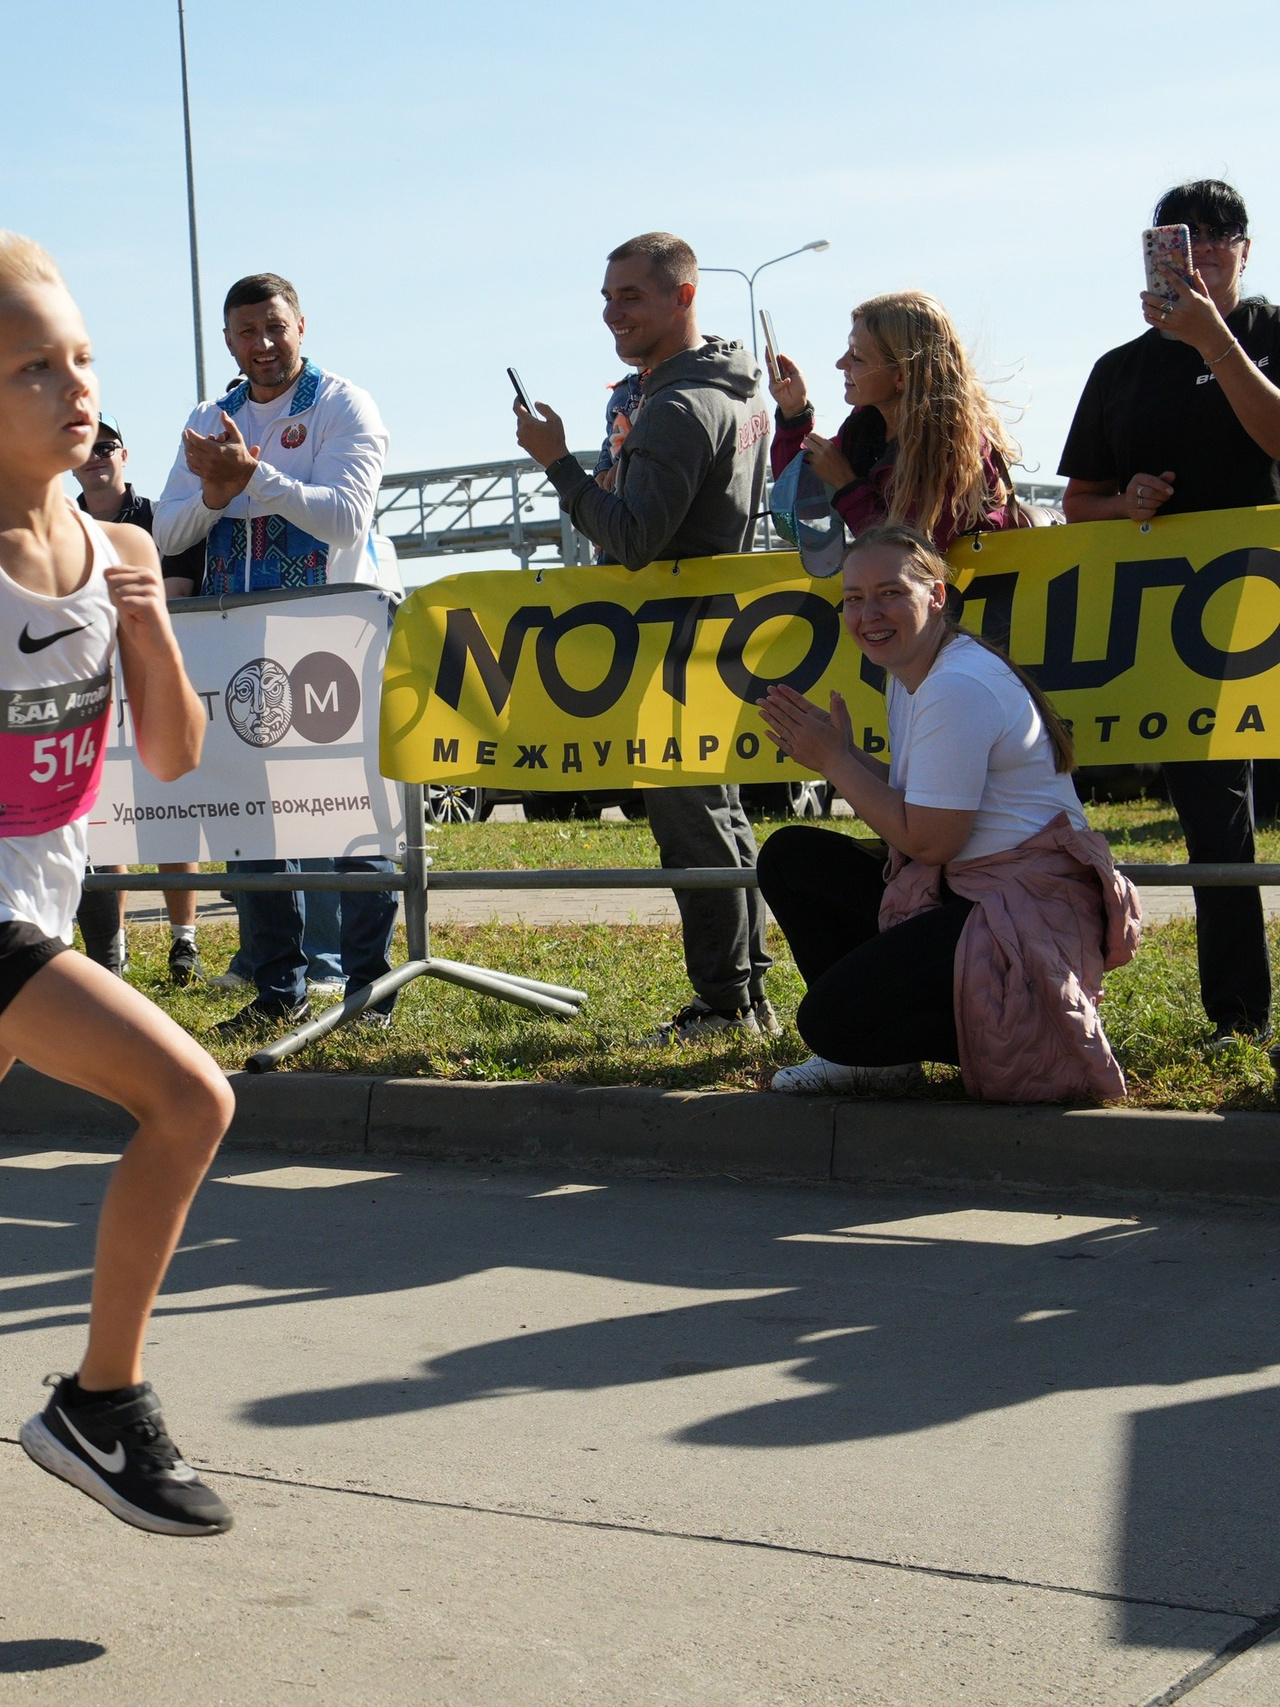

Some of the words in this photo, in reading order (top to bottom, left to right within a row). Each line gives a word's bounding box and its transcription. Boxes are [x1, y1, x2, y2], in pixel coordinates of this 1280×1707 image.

[29, 727, 96, 783] 514
[112, 801, 241, 826] Удовольствие
[245, 800, 266, 816] от
[272, 795, 371, 820] вождения
